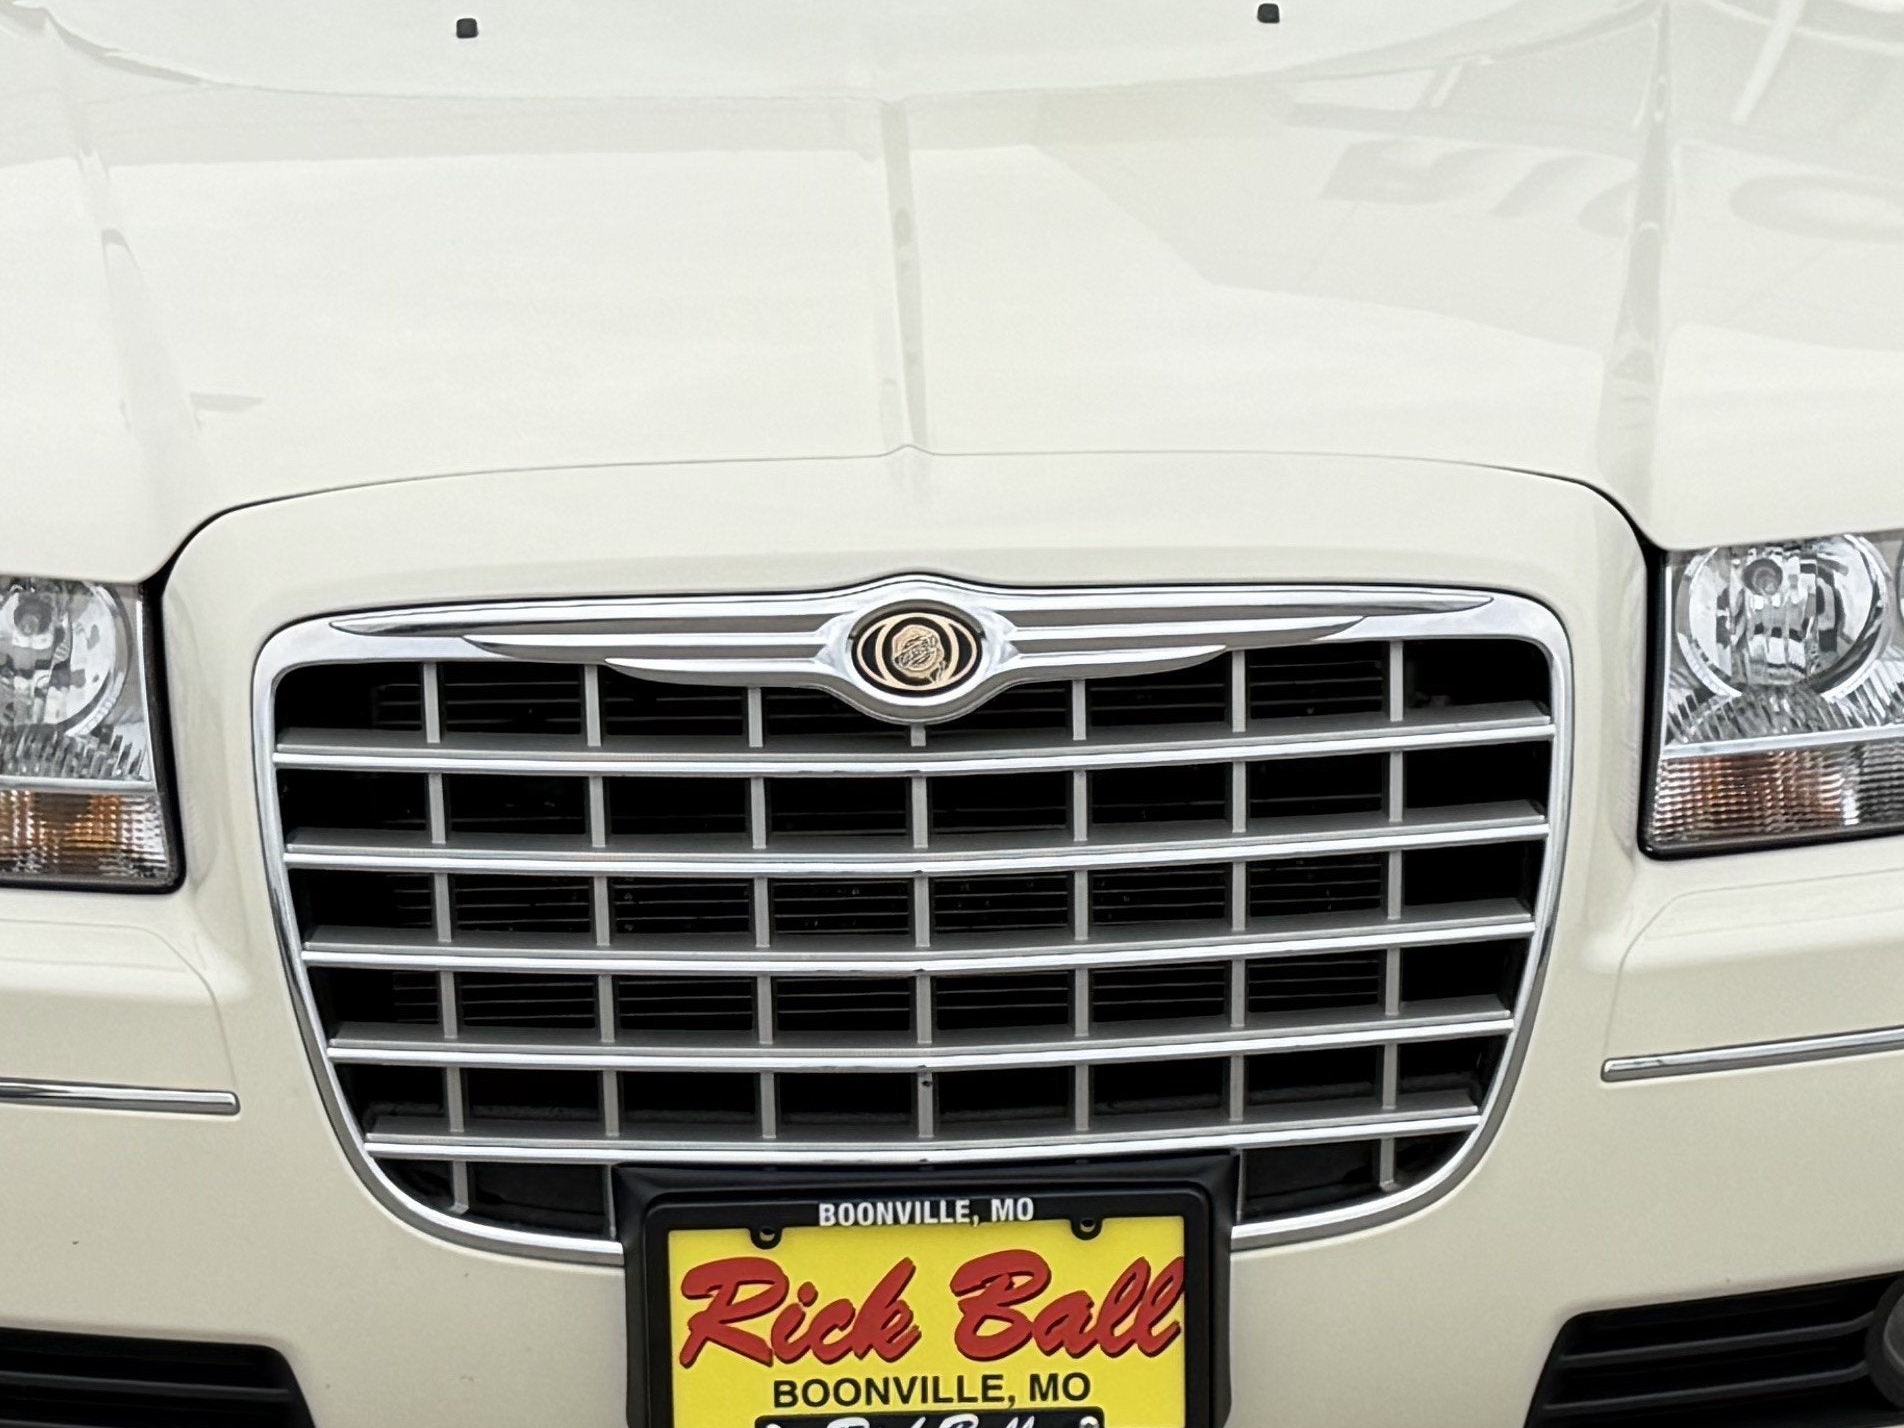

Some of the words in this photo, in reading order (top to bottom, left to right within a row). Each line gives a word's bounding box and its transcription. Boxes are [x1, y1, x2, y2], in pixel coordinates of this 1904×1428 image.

[818, 1198, 982, 1227] BOONVILLE,
[991, 1197, 1035, 1223] MO
[678, 1256, 923, 1369] Rick
[949, 1249, 1186, 1362] Ball
[772, 1373, 1017, 1409] BOONVILLE,
[1028, 1372, 1092, 1403] MO
